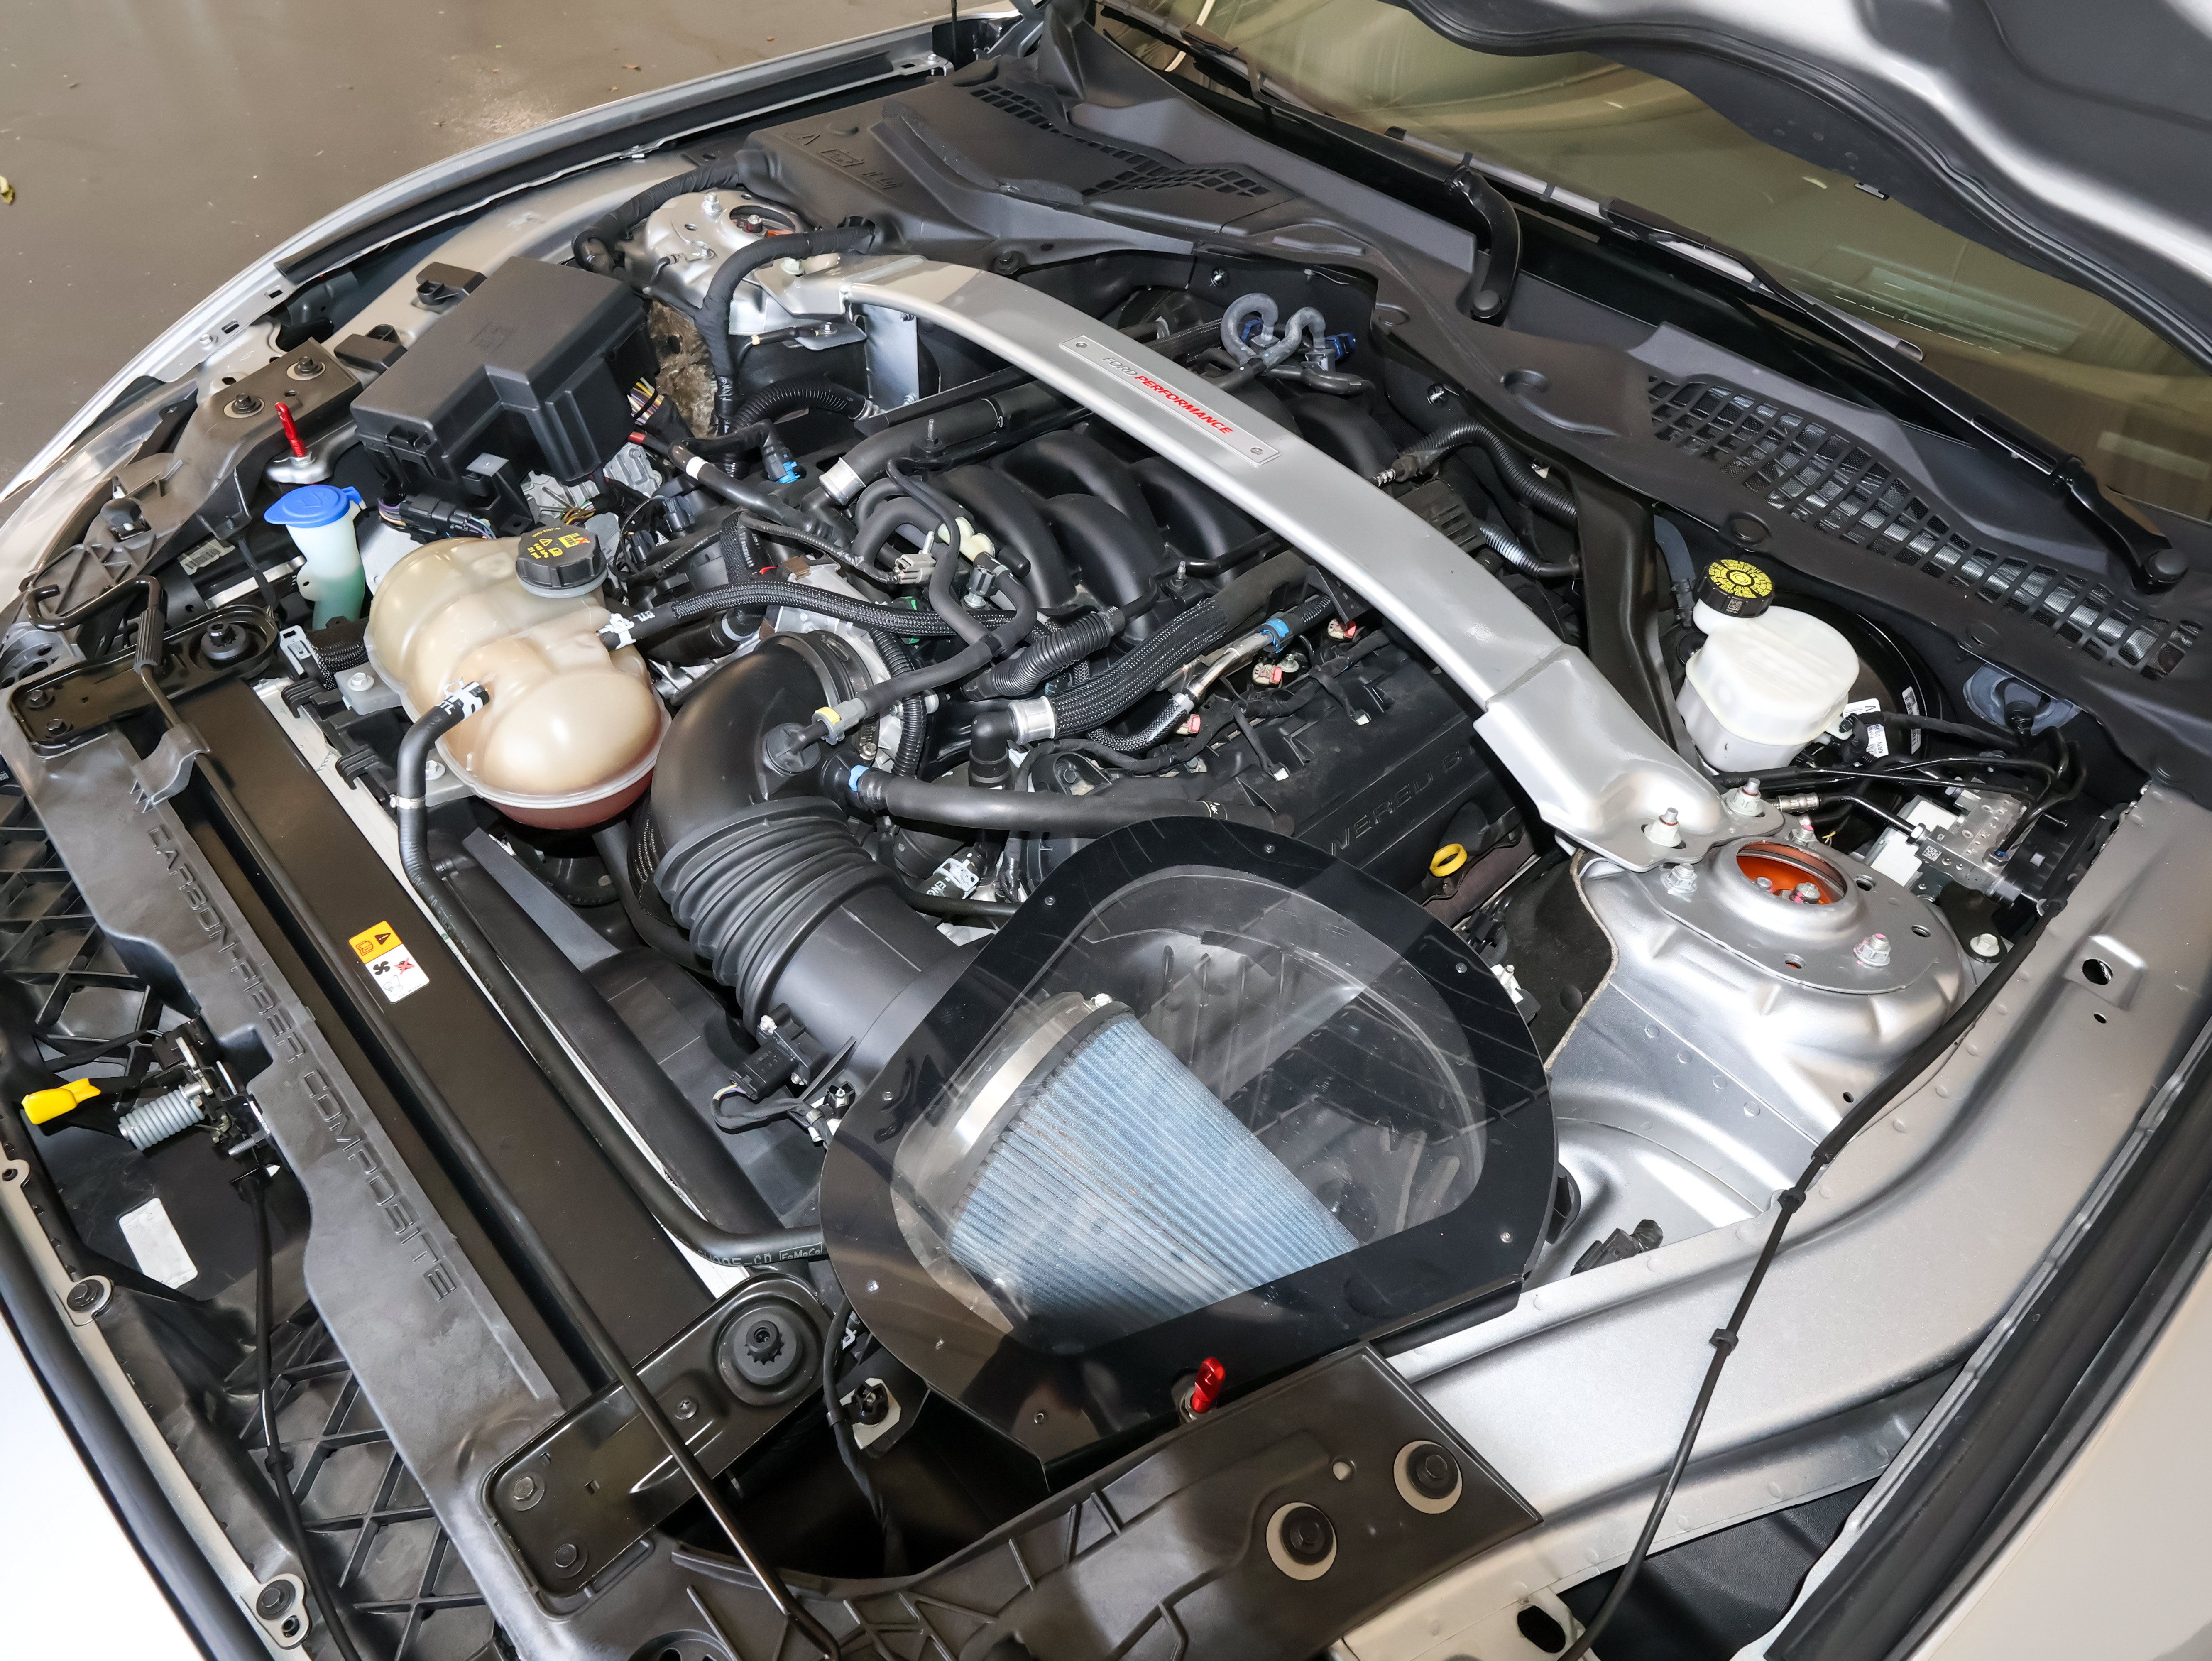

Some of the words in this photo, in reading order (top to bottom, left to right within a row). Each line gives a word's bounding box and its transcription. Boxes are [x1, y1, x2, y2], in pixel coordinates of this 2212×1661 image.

[1101, 357, 1138, 377] FORD
[1134, 375, 1235, 435] PERFORMANCE
[148, 828, 306, 1064] CARBON-FIBER
[303, 1071, 458, 1302] COMPOSITE
